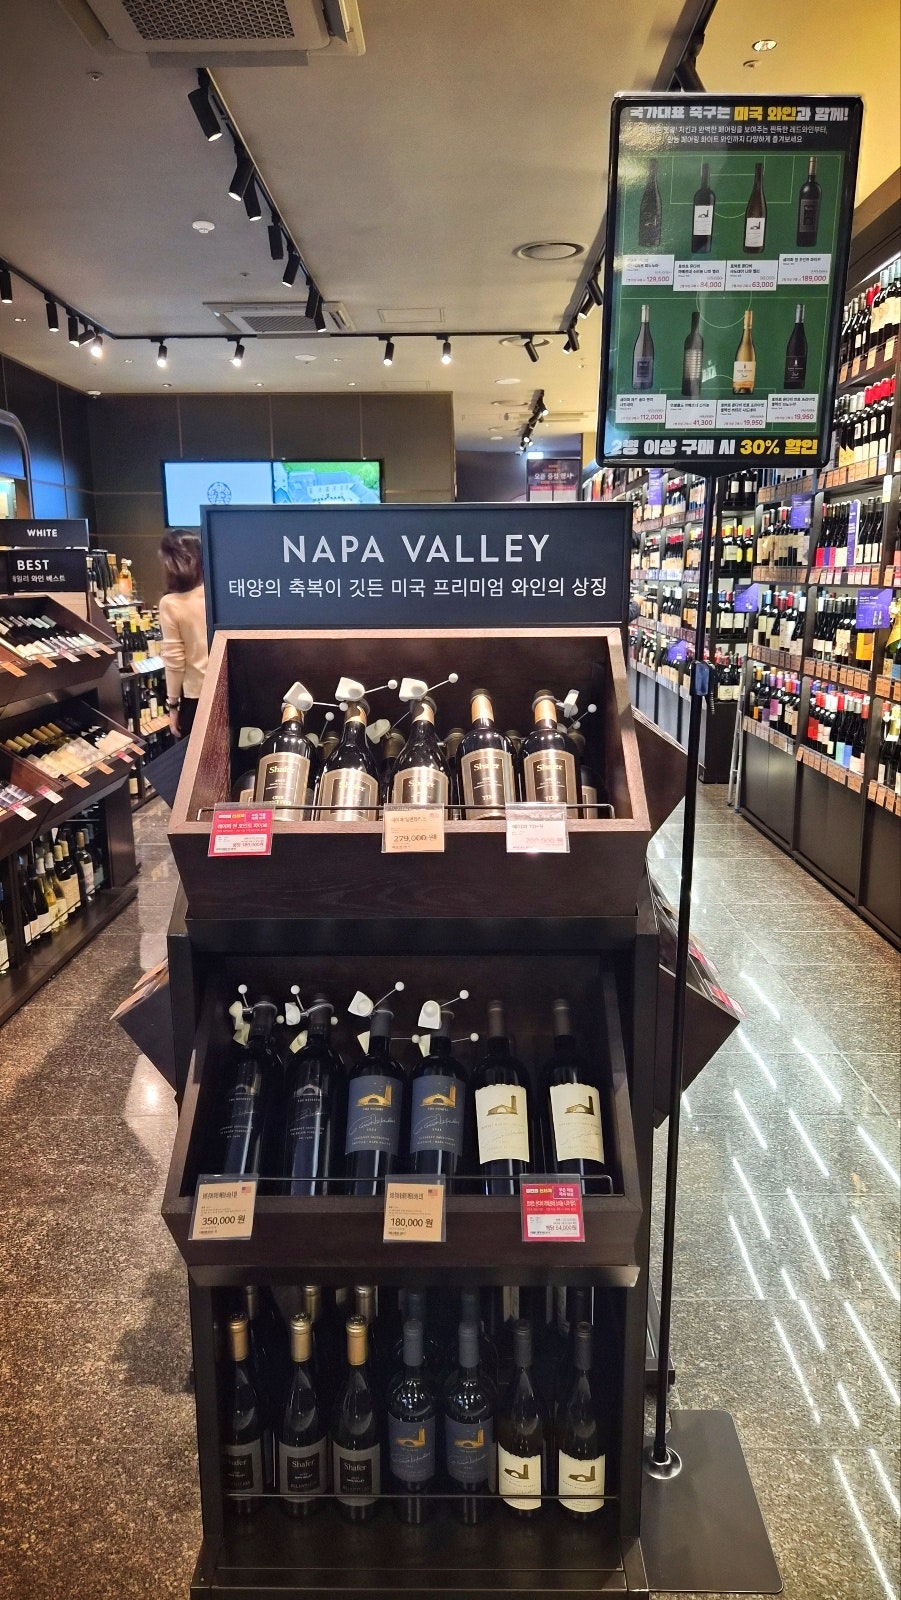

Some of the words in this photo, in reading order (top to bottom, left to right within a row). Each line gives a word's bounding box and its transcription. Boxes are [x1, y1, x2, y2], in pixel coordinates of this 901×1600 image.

[630, 106, 685, 119] 국가대표
[734, 106, 763, 121] 미국
[767, 106, 811, 121] 와인과
[815, 106, 849, 122] 함께!
[611, 440, 639, 455] 2병
[644, 440, 677, 455] 이상
[682, 440, 714, 455] 구매
[719, 440, 735, 455] 시
[740, 439, 779, 455] 30%
[784, 438, 818, 455] 할인
[27, 528, 58, 537] WHITE
[283, 535, 385, 563] NAPA
[401, 534, 551, 563] VALLEY
[16, 559, 50, 571] BEST
[31, 575, 45, 583] 와인
[229, 577, 282, 598] 태양의
[288, 577, 342, 598] 축복이
[350, 577, 385, 598] 깃든
[391, 577, 426, 598] 미국
[433, 577, 504, 598] 프리미엄
[511, 576, 565, 597] 와인의
[572, 576, 608, 597] 상징
[473, 762, 500, 771] Shafer
[537, 764, 563, 772] Shafer
[393, 834, 427, 842] 279,000
[428, 833, 437, 841] 원
[202, 1215, 236, 1226] 350,000
[237, 1215, 246, 1224] 원
[391, 1218, 424, 1227] 180,000
[425, 1218, 434, 1228] 원
[291, 1458, 316, 1468] Shafer
[343, 1462, 368, 1472] Shafer
